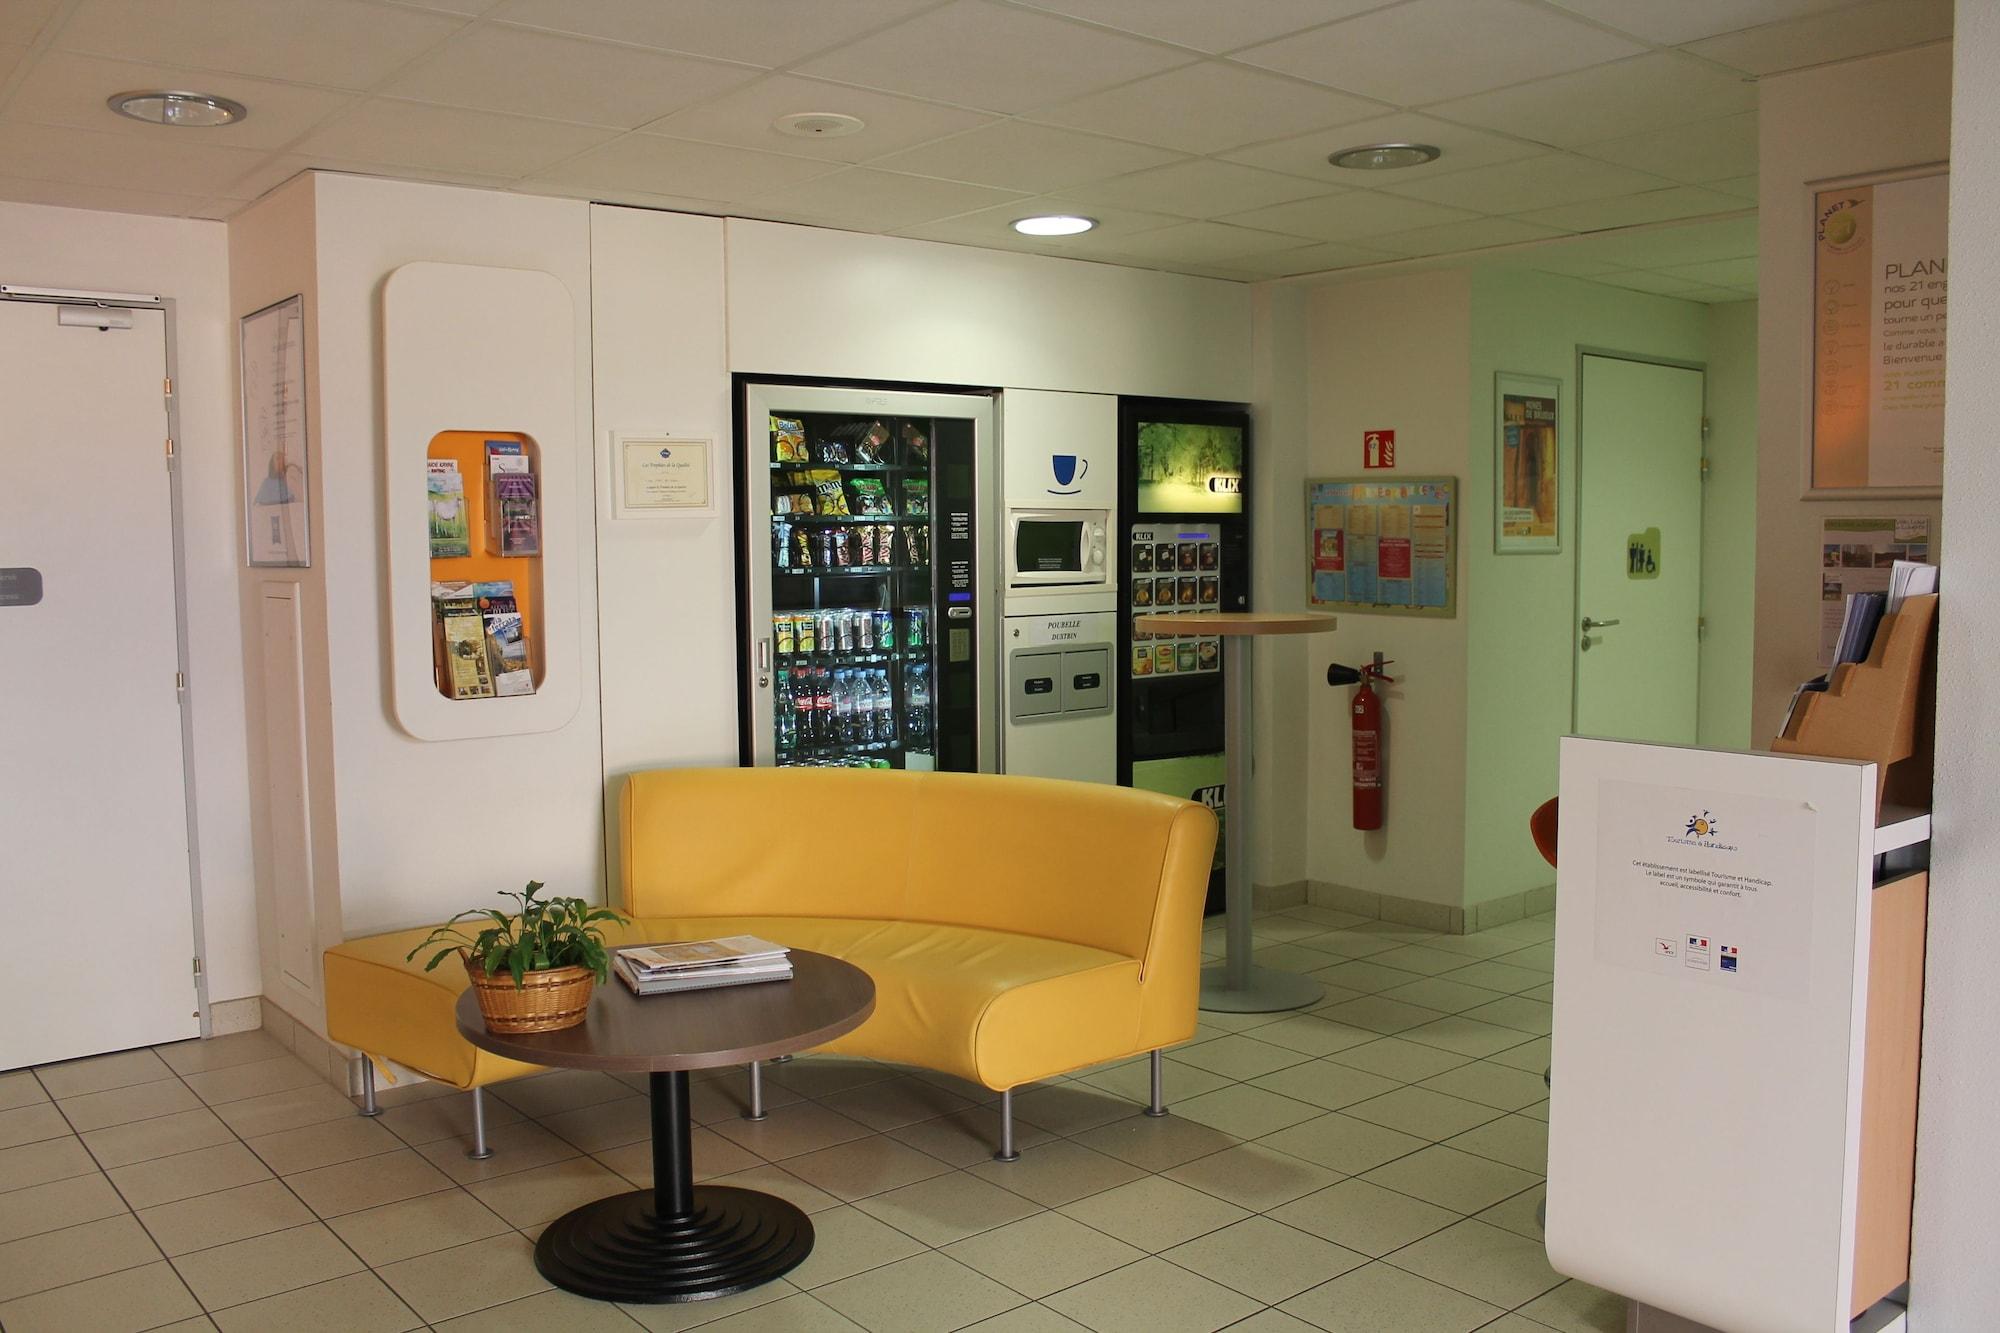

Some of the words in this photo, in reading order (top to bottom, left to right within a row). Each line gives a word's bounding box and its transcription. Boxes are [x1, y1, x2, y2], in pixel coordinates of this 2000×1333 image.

[1909, 280, 1923, 291] 21
[1884, 298, 1917, 314] pour
[1883, 315, 1918, 325] tourne
[1920, 313, 1934, 321] un
[1895, 338, 1935, 350] durable
[1883, 353, 1943, 365] Bienvenue
[1135, 532, 1152, 541] KLIX
[1047, 620, 1081, 629] POUBELLE
[1051, 632, 1078, 641] DUSTBIN
[1632, 859, 1641, 867] Cet
[1711, 871, 1737, 881] Tourisme
[1653, 870, 1666, 878] label
[1683, 874, 1707, 885] symbole
[1707, 878, 1717, 887] qui
